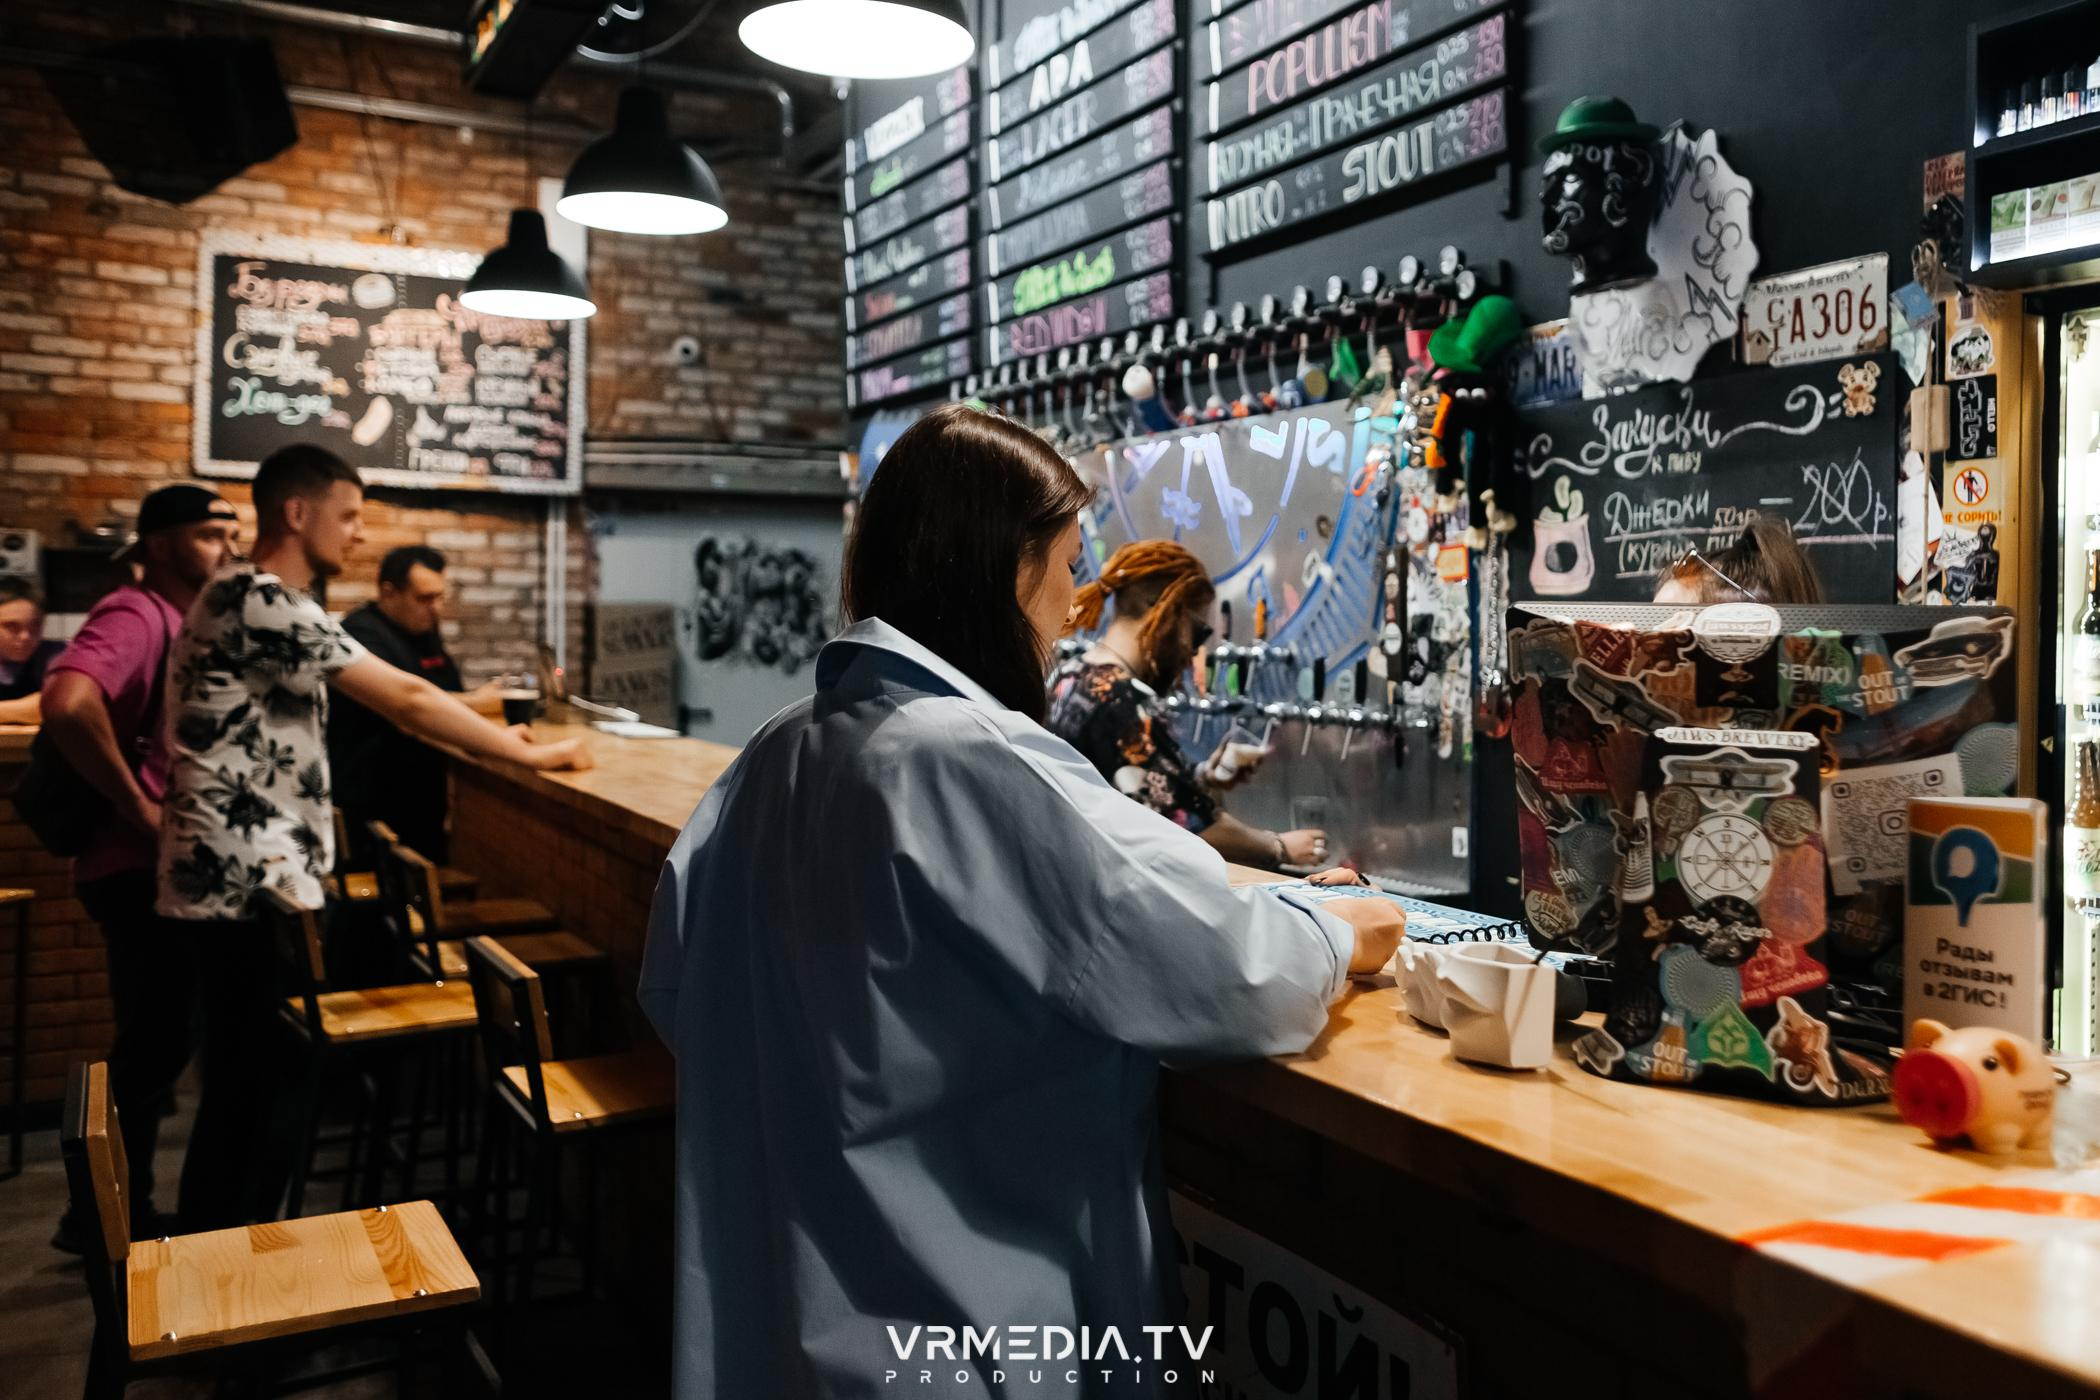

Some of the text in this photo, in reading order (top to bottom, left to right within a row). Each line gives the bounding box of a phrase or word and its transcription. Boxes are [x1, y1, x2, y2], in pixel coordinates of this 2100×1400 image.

[1248, 0, 1391, 115] POPULISM
[1342, 121, 1435, 203] STOUT
[1580, 387, 1720, 479] Закуски
[1858, 671, 1893, 690] OUT
[1853, 685, 1909, 708] STOUT
[1667, 727, 1807, 748] JAWS BREWERY
[1936, 936, 1994, 964] Рады
[1919, 959, 2014, 987] отзывам
[1938, 981, 2008, 1010] 2ГИС!
[1652, 1041, 1690, 1063] OUT
[1640, 1056, 1697, 1081] STOUT
